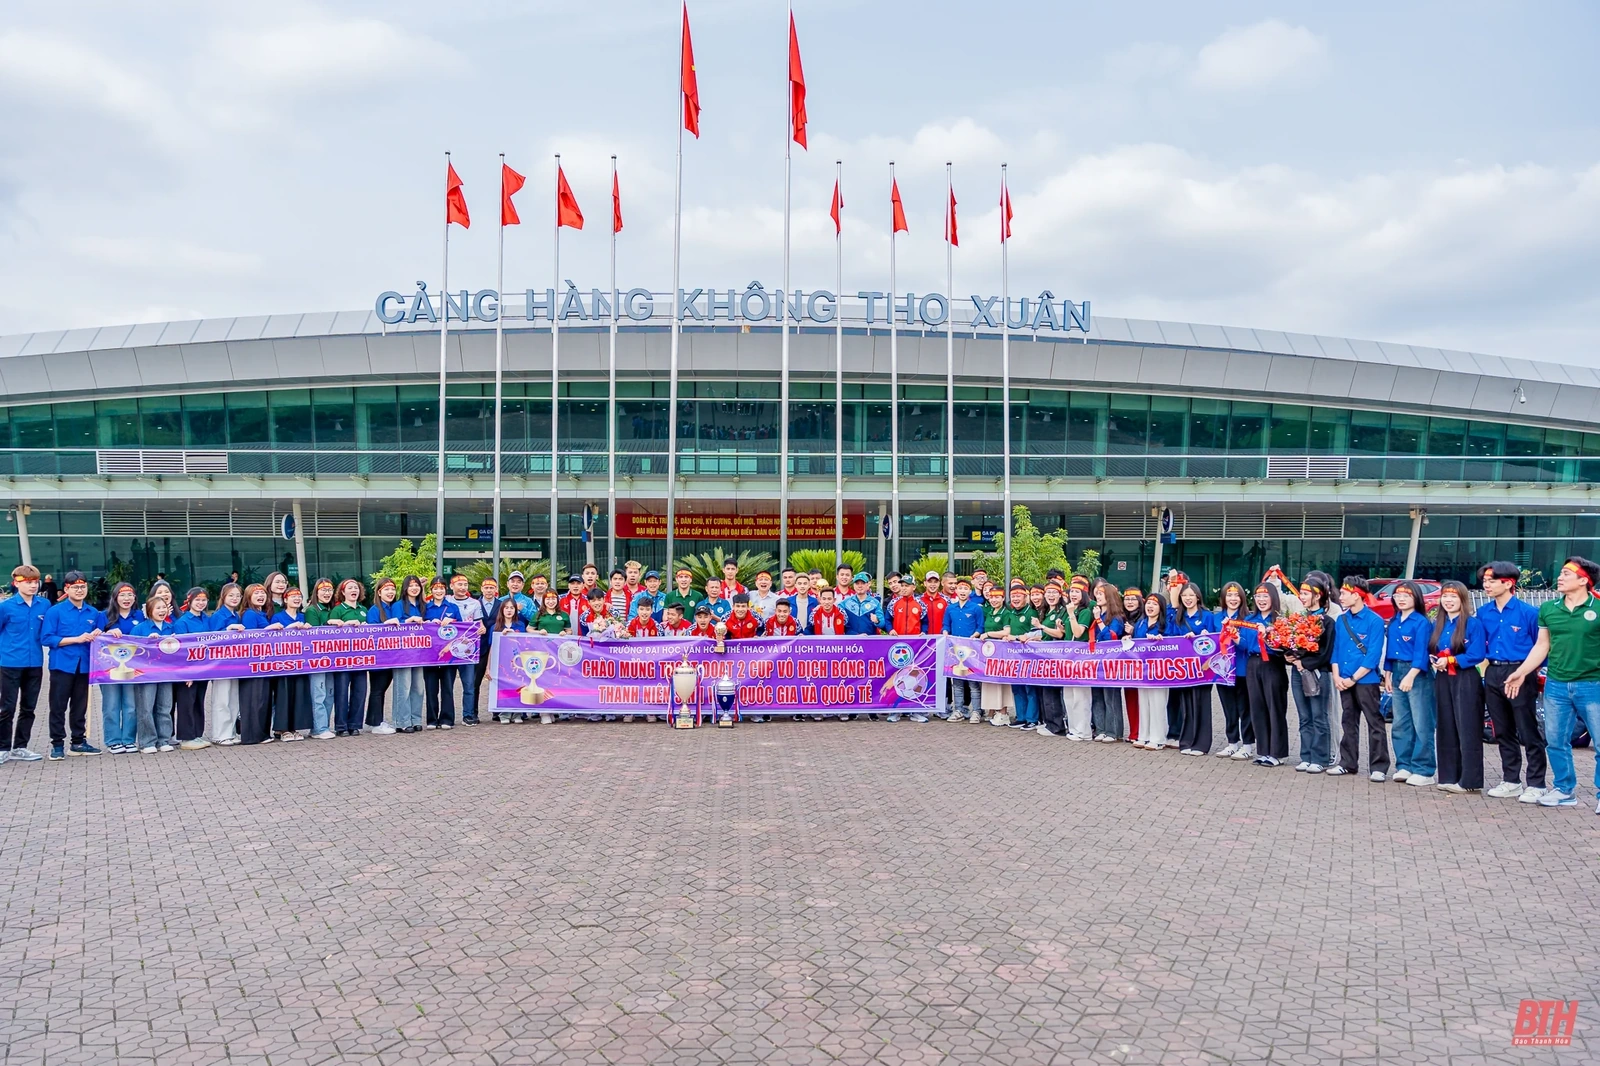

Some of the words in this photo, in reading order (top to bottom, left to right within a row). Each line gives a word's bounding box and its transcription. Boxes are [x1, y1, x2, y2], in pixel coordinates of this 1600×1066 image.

[375, 281, 500, 324] CẢNG
[526, 279, 653, 321] HÀNG
[678, 280, 837, 323] KHÔNG
[858, 291, 949, 333] THỌ
[970, 290, 1091, 332] XUÂN
[680, 527, 691, 535] CÁC
[703, 527, 710, 535] VÀ
[196, 634, 230, 643] TRƯỜNG
[232, 633, 246, 641] ĐẠI
[248, 632, 266, 640] HỌC
[268, 629, 283, 638] VĂN
[366, 626, 382, 634] LỊCH
[187, 644, 206, 661] XỨ
[209, 645, 250, 660] THANH
[252, 643, 272, 660] ĐỊA
[275, 641, 302, 657] LINH
[311, 639, 350, 654] THANH
[351, 635, 375, 651] HOÁ
[377, 637, 400, 650] ANH
[402, 633, 432, 649] HÙNG
[609, 645, 642, 654] TRƯỜNG
[645, 646, 659, 655] ĐẠI
[662, 646, 680, 655] HỌC
[683, 645, 701, 653] VĂN
[743, 645, 765, 654] THAO
[767, 644, 779, 653] VÀ
[795, 646, 814, 655] LỊCH
[845, 644, 864, 653] HÓA
[1148, 644, 1179, 652] TOURISM
[249, 659, 305, 673] TUCST
[308, 657, 331, 669] VÔ
[334, 656, 376, 668] ĐỊCH
[582, 657, 616, 679] CHÀO
[619, 657, 656, 679] MỪNG
[737, 659, 746, 679] 2
[777, 657, 795, 679] VÔ
[797, 659, 827, 682] ĐỊCH
[831, 657, 865, 679] BÓNG
[868, 657, 886, 679] ĐÁ
[984, 658, 1019, 679] MAKE
[1019, 659, 1031, 679] IT
[1030, 659, 1100, 680] LEGENDARY
[1102, 658, 1143, 680] WITH
[1146, 656, 1204, 680] TUCST!
[598, 685, 640, 704] THANH
[642, 683, 671, 705] NIÊN
[739, 680, 774, 707] QUỐC
[776, 684, 799, 705] GIA
[801, 682, 818, 705] VÀ
[820, 680, 855, 706] QUỐC
[858, 679, 873, 705] TẾ
